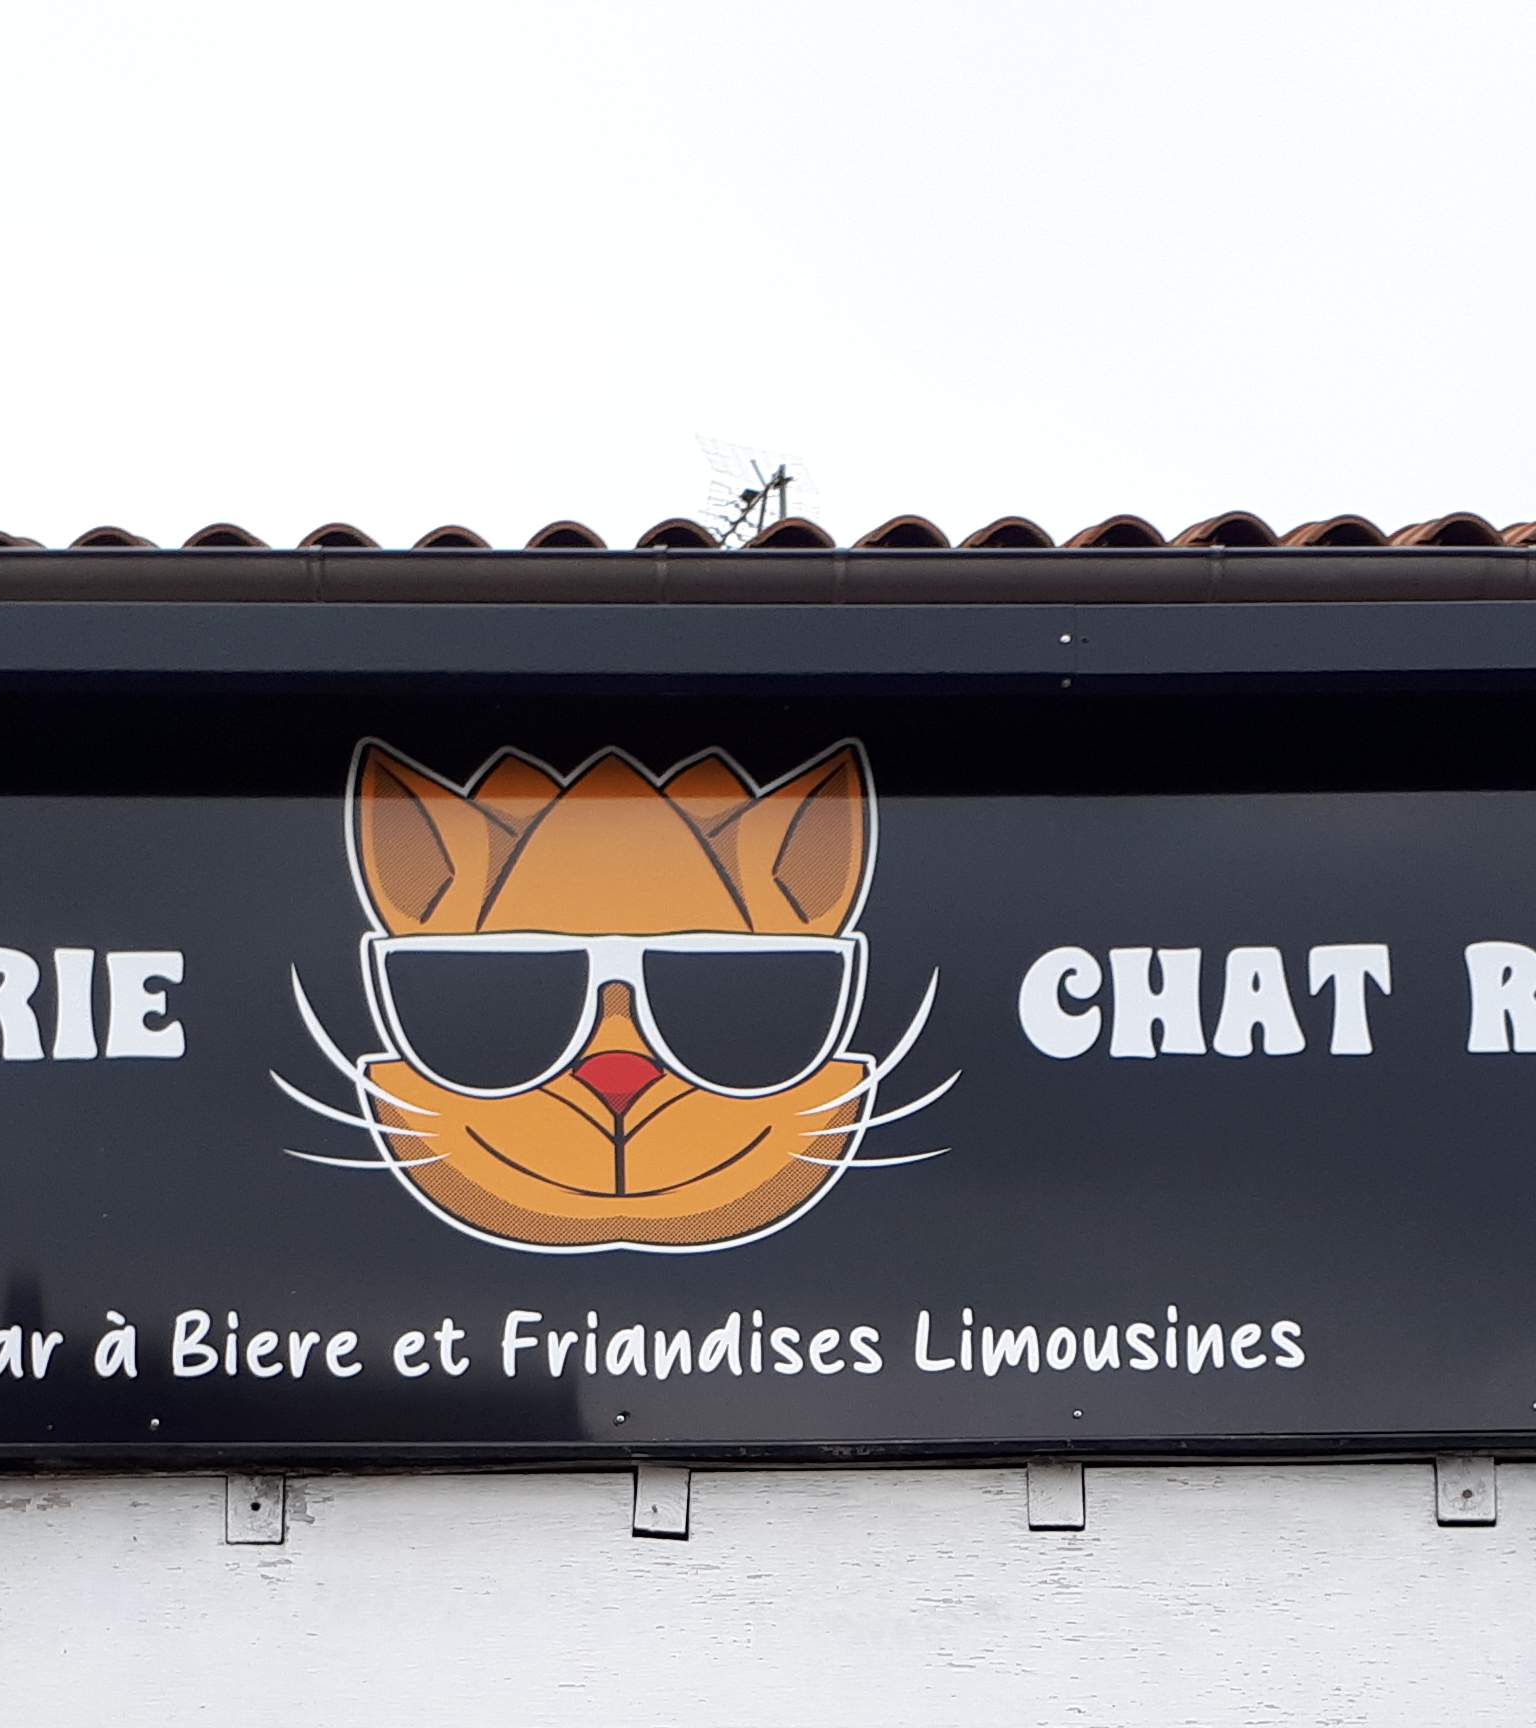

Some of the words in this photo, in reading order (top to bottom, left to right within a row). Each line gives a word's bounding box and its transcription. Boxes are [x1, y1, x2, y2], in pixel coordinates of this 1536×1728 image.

[1019, 944, 1390, 1058] CHAT
[95, 1311, 137, 1377] à
[173, 1310, 362, 1377] Biere
[394, 1318, 469, 1376] et
[502, 1310, 882, 1380] Friandises
[915, 1306, 1304, 1376] Limousines
